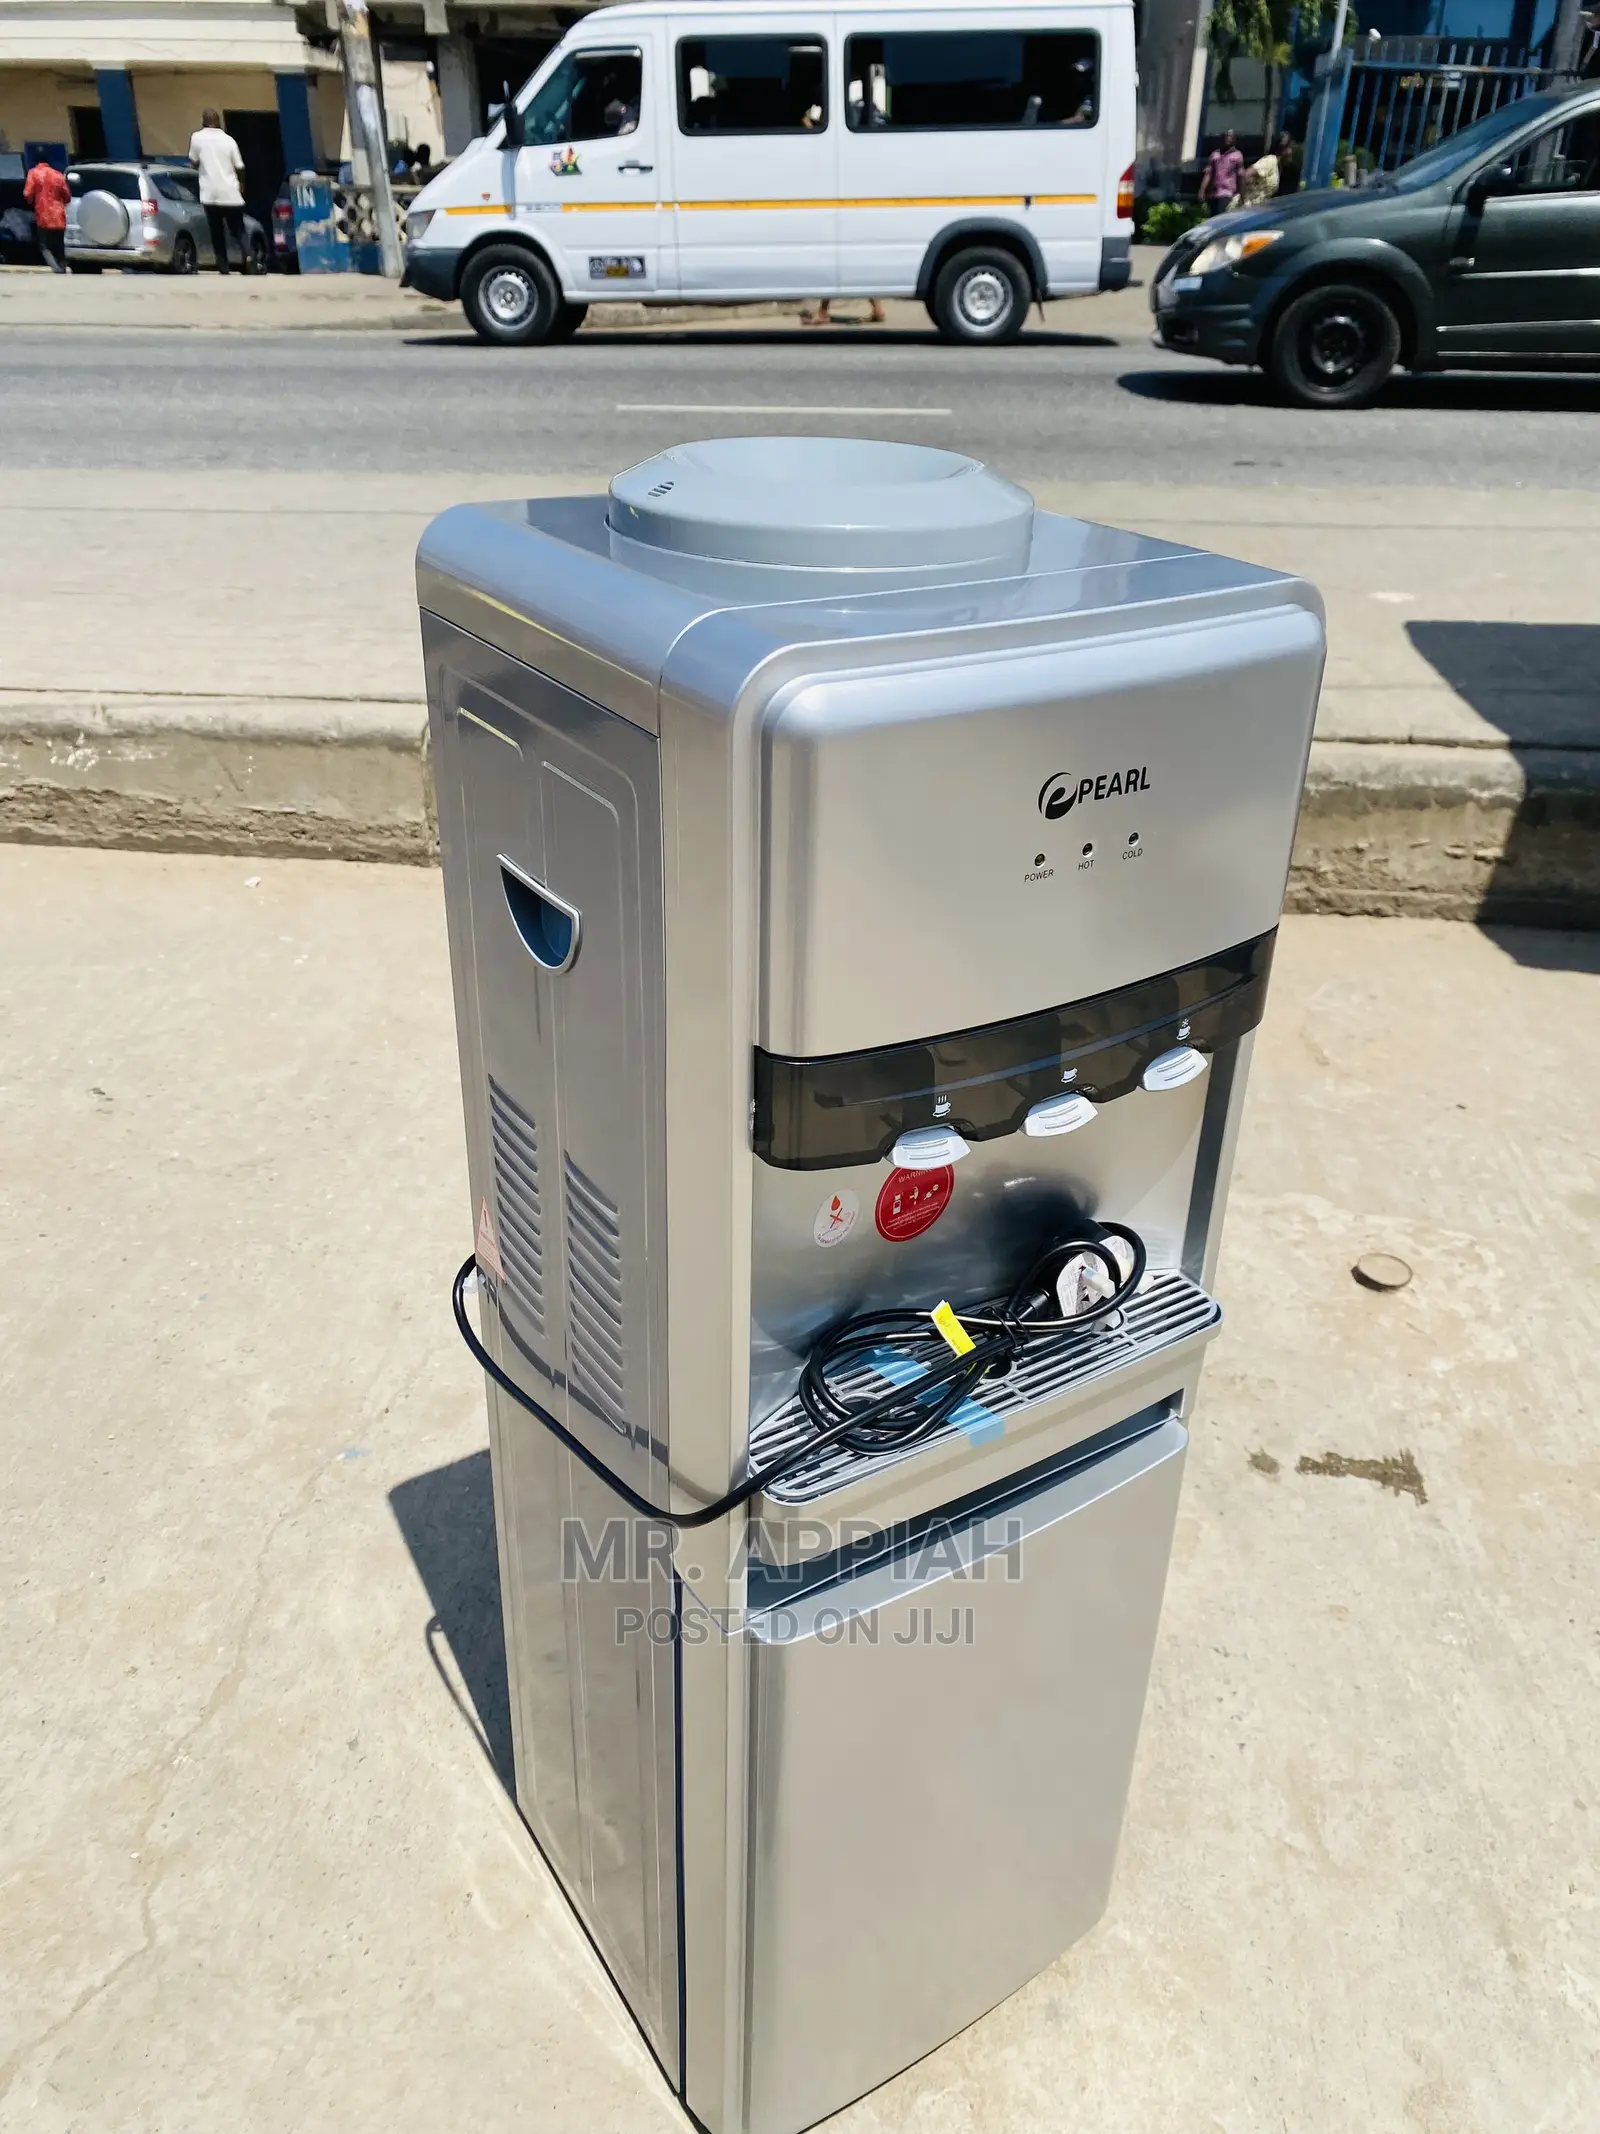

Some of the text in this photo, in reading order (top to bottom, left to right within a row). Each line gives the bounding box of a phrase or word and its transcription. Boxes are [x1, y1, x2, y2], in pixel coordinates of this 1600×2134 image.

[297, 186, 316, 208] IN
[1121, 848, 1144, 861] COLD
[1077, 859, 1095, 871] HOT
[1023, 868, 1055, 882] POWER
